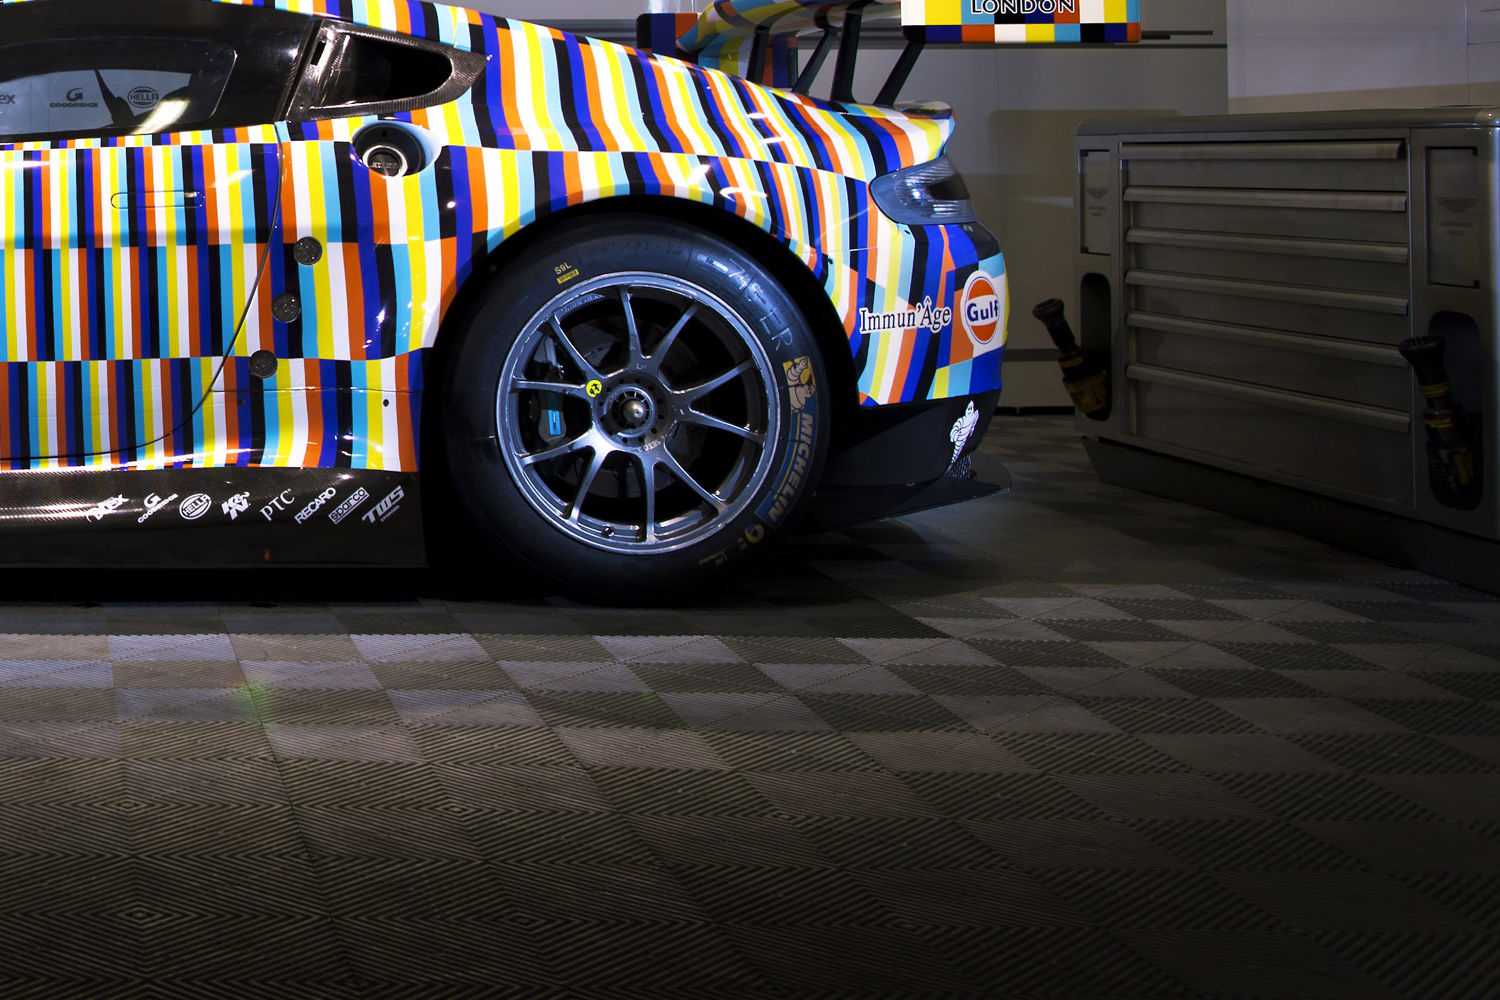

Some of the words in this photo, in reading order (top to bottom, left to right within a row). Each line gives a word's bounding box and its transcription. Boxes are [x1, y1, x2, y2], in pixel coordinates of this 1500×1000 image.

[129, 93, 159, 101] HELLA
[967, 300, 999, 322] Gulf
[768, 413, 814, 525] MICHELIN
[182, 494, 211, 516] HELLA
[293, 487, 337, 525] RECARO
[329, 488, 366, 522] sparco
